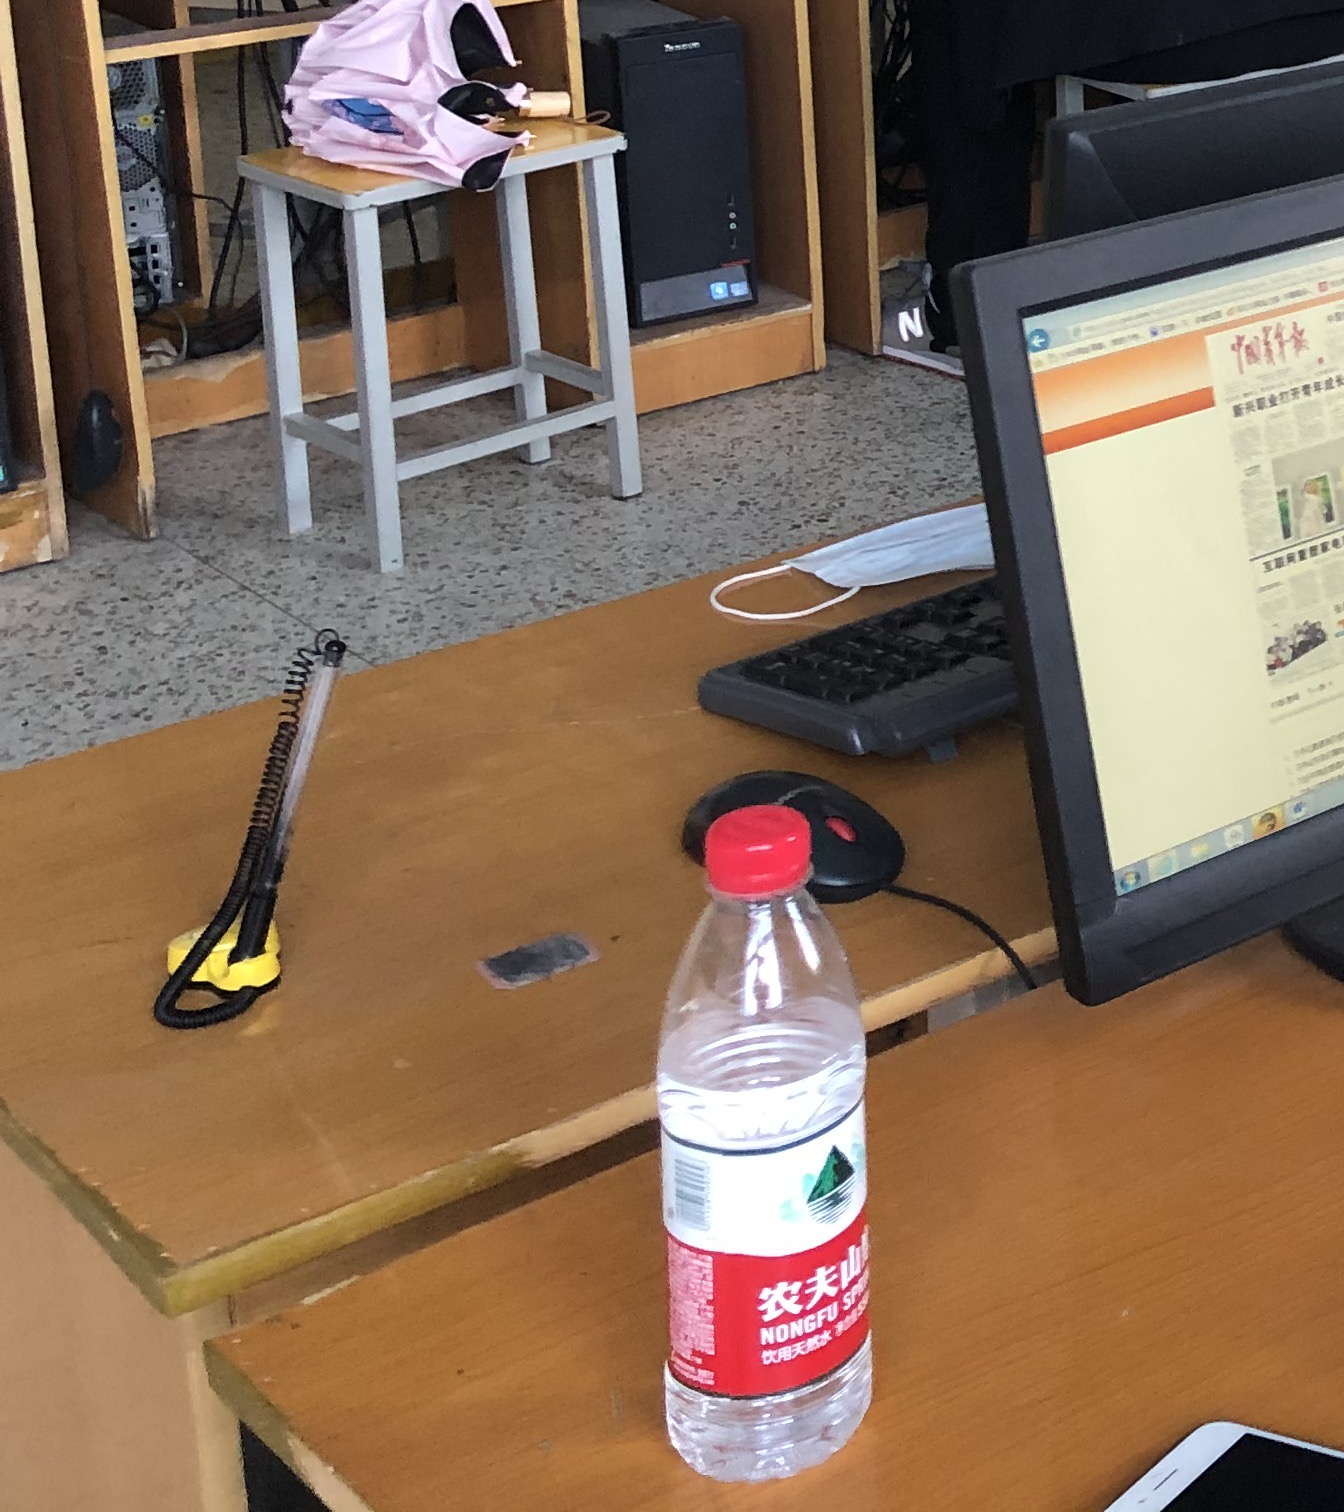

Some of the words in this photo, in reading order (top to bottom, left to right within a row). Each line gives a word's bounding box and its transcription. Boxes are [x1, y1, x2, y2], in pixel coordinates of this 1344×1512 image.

[760, 1302, 839, 1345] NONGFU
[761, 1329, 832, 1366] 饮用天然水
